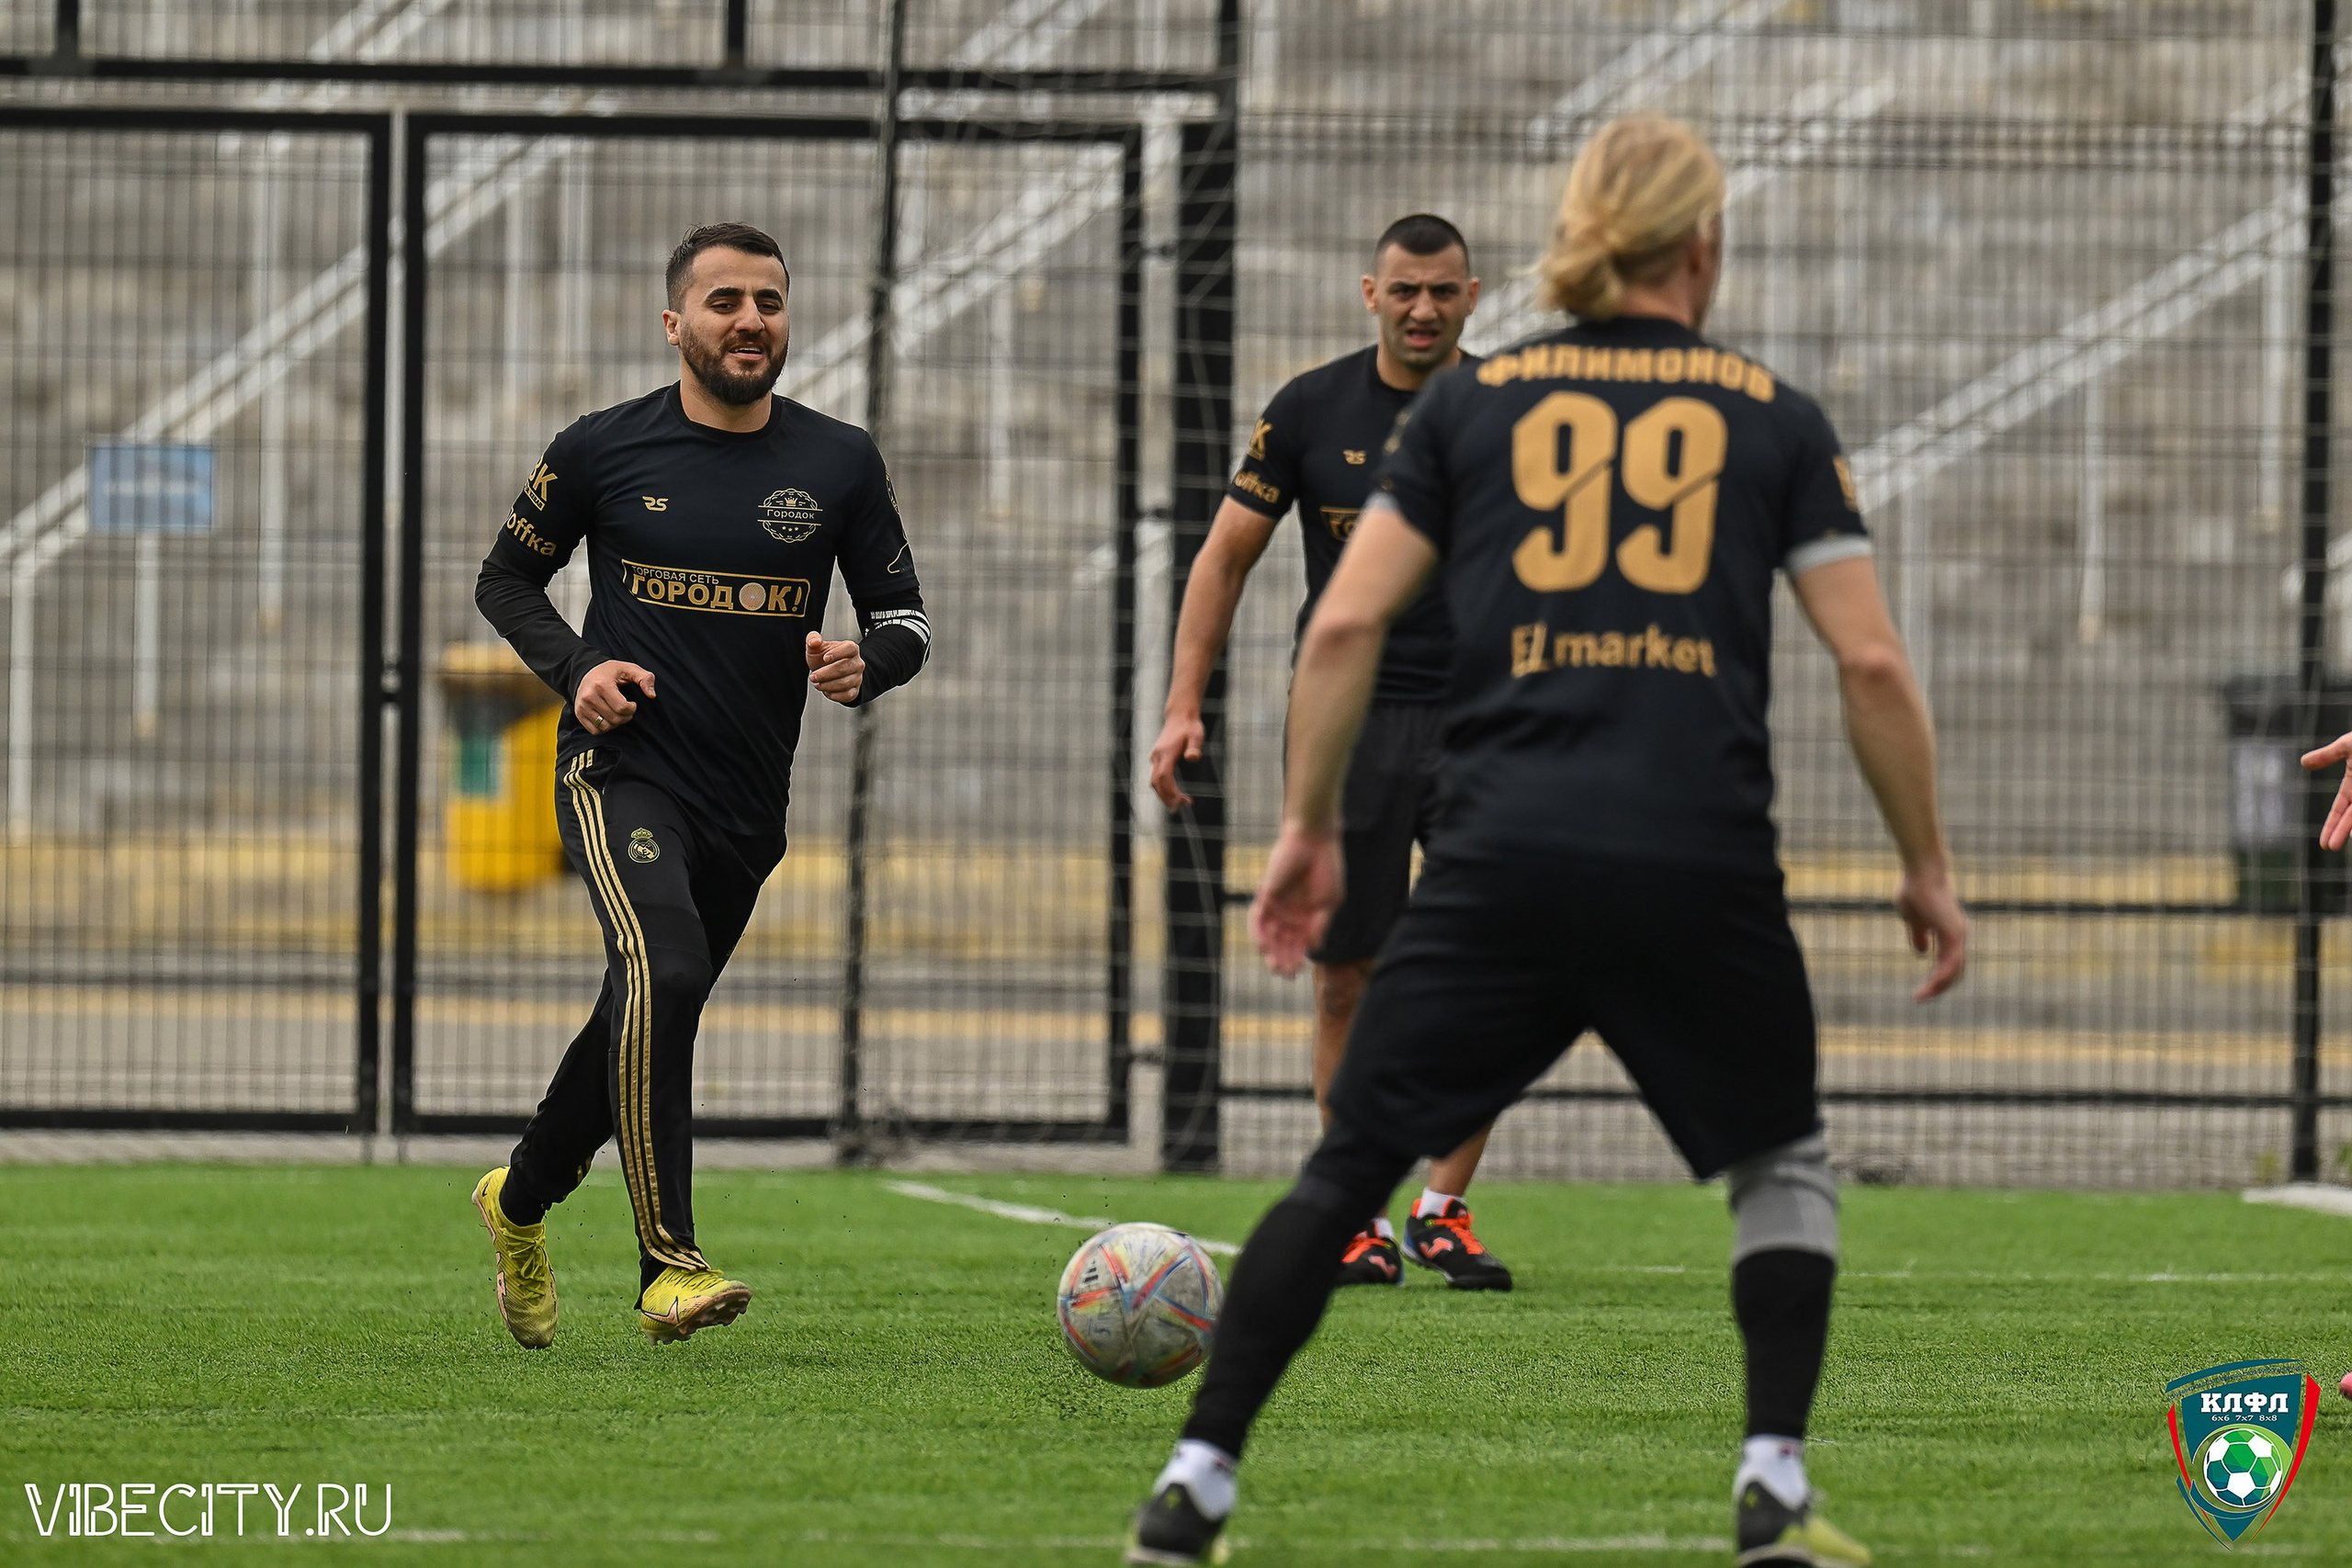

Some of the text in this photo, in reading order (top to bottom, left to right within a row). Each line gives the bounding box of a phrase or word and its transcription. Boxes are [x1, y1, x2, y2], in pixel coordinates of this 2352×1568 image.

[1476, 344, 1776, 402] ФИЛИМОНОВ
[1511, 390, 1727, 594] 99
[766, 508, 815, 520] Городок
[631, 565, 719, 585] ТОРГОВАЯ СЕТЬ
